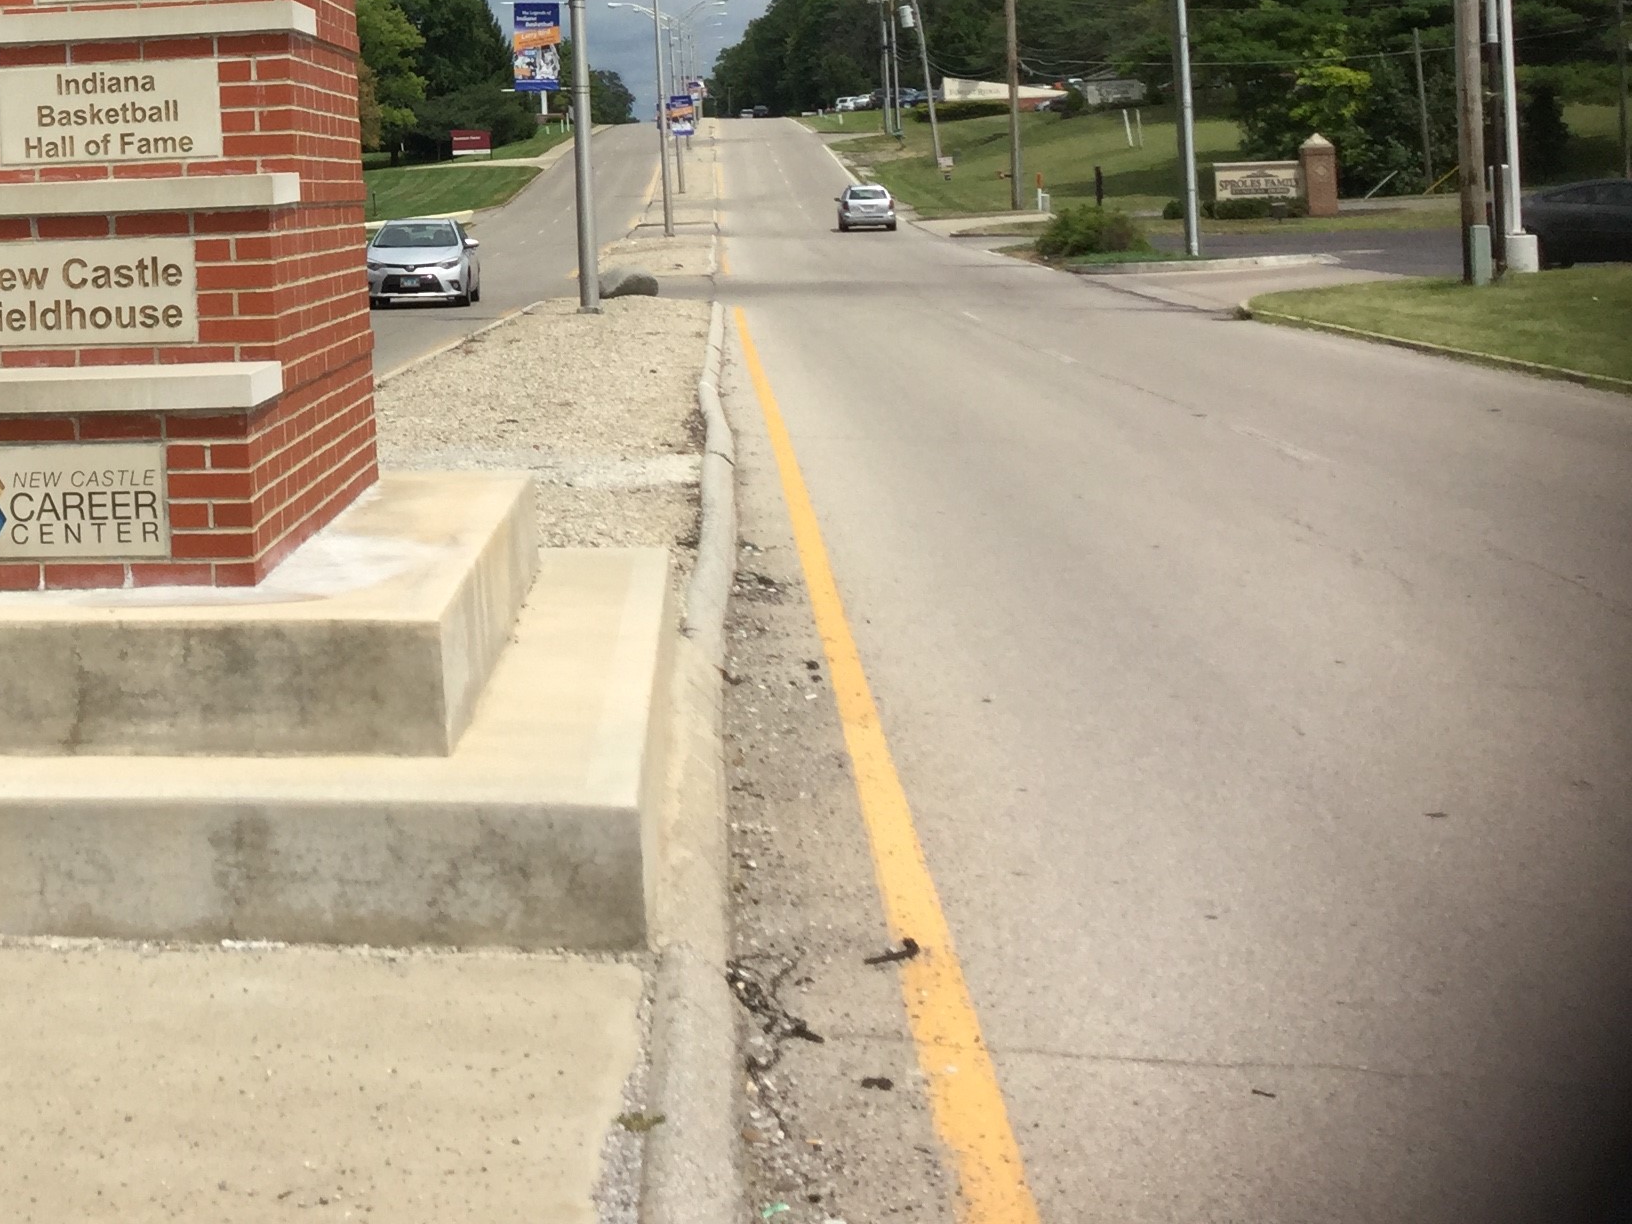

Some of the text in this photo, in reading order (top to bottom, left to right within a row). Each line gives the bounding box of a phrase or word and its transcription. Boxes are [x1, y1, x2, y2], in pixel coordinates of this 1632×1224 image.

[56, 72, 156, 96] Indiana
[37, 99, 179, 127] Basketball
[24, 132, 194, 159] Hall of Fame
[62, 256, 183, 289] Castle
[13, 469, 156, 488] NEW CASTLE
[9, 490, 158, 522] CAREER
[11, 522, 160, 545] CENTER
